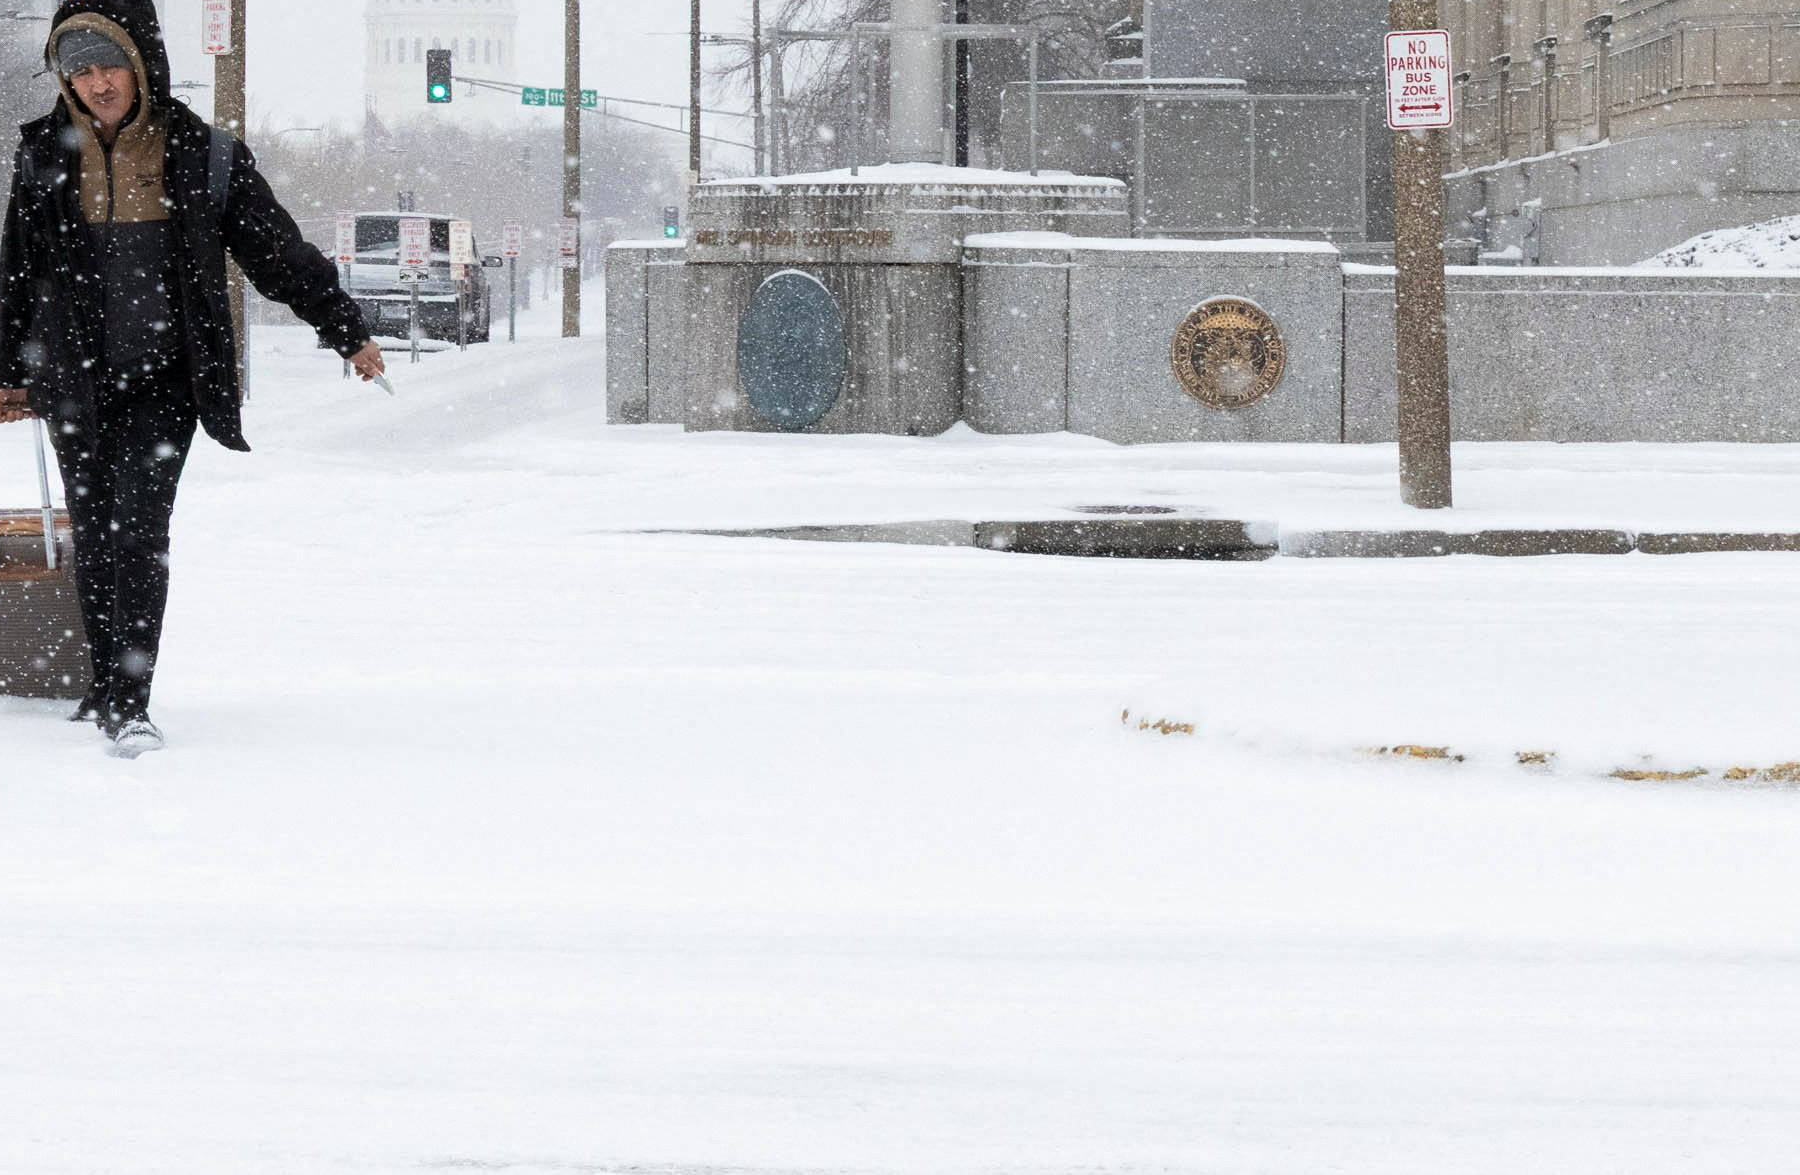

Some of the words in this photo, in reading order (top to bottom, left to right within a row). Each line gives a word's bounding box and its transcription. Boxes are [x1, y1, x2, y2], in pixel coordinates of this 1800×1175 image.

[1408, 40, 1427, 54] NO
[1391, 55, 1446, 71] PARKING
[1405, 72, 1432, 83] BUS
[1402, 85, 1437, 96] ZONE
[580, 92, 596, 104] St
